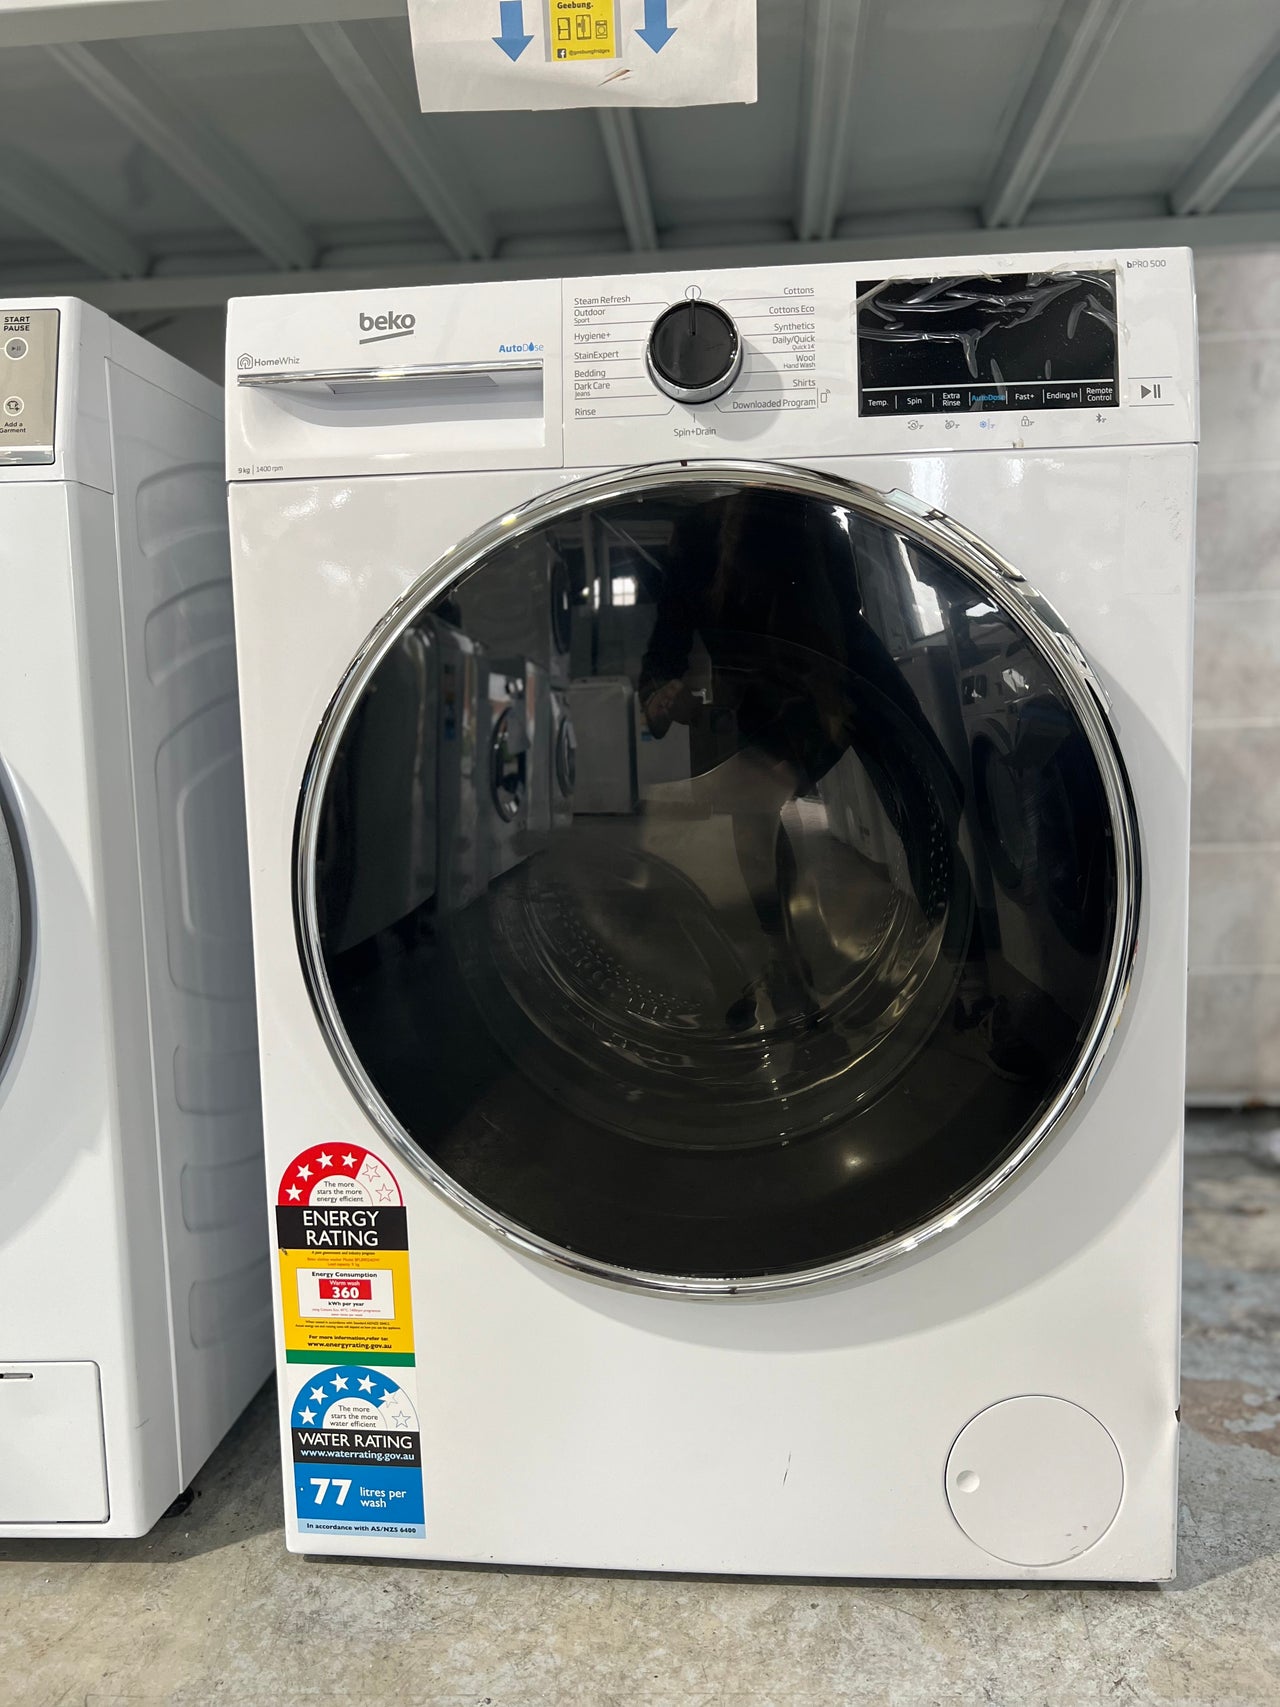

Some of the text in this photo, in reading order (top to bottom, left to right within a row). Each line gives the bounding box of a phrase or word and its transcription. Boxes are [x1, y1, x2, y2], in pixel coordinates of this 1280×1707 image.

[557, 1, 594, 9] Geebung.
[1127, 259, 1167, 268] bPRO 500
[783, 286, 815, 295] Cottons
[574, 295, 631, 306] Steam Refresh
[574, 308, 606, 317] Outdoor
[769, 305, 815, 315] Cottons Eco
[359, 311, 416, 332] beko
[574, 317, 590, 325] Sport
[774, 322, 815, 332] Synthetics
[574, 332, 611, 342] Hygiene+
[772, 335, 815, 345] Daily/Quick
[574, 350, 619, 360] StainExpert
[254, 356, 300, 367] HomeWhiz
[574, 369, 606, 379] Bedding
[574, 381, 611, 391] Dark Care
[792, 378, 816, 387] Shirts
[574, 390, 591, 398] Jeans
[942, 392, 960, 400] Extra
[1046, 392, 1070, 400] Ending
[1087, 394, 1112, 402] Control
[732, 398, 816, 410] Downloaded Program
[868, 399, 889, 408] Temp.
[907, 397, 922, 406] Spin
[574, 408, 597, 416] Rinse
[673, 427, 717, 438] Spin+Drain
[243, 466, 251, 475] kg
[256, 465, 271, 473] 1400
[272, 465, 284, 473] rpm
[303, 1210, 379, 1227] ENERGY
[306, 1230, 379, 1246] RATING
[332, 1286, 359, 1298] 360
[307, 1341, 393, 1350] www.energyrating.gov.au
[298, 1432, 413, 1449] WATER RATING
[300, 1450, 415, 1461] www.waterrating.gov.au
[310, 1478, 352, 1506] 77
[360, 1487, 407, 1500] litres per
[360, 1498, 387, 1508] wash
[315, 1523, 353, 1531] accordance
[353, 1524, 369, 1532] with
[371, 1525, 398, 1533] AS/NZS
